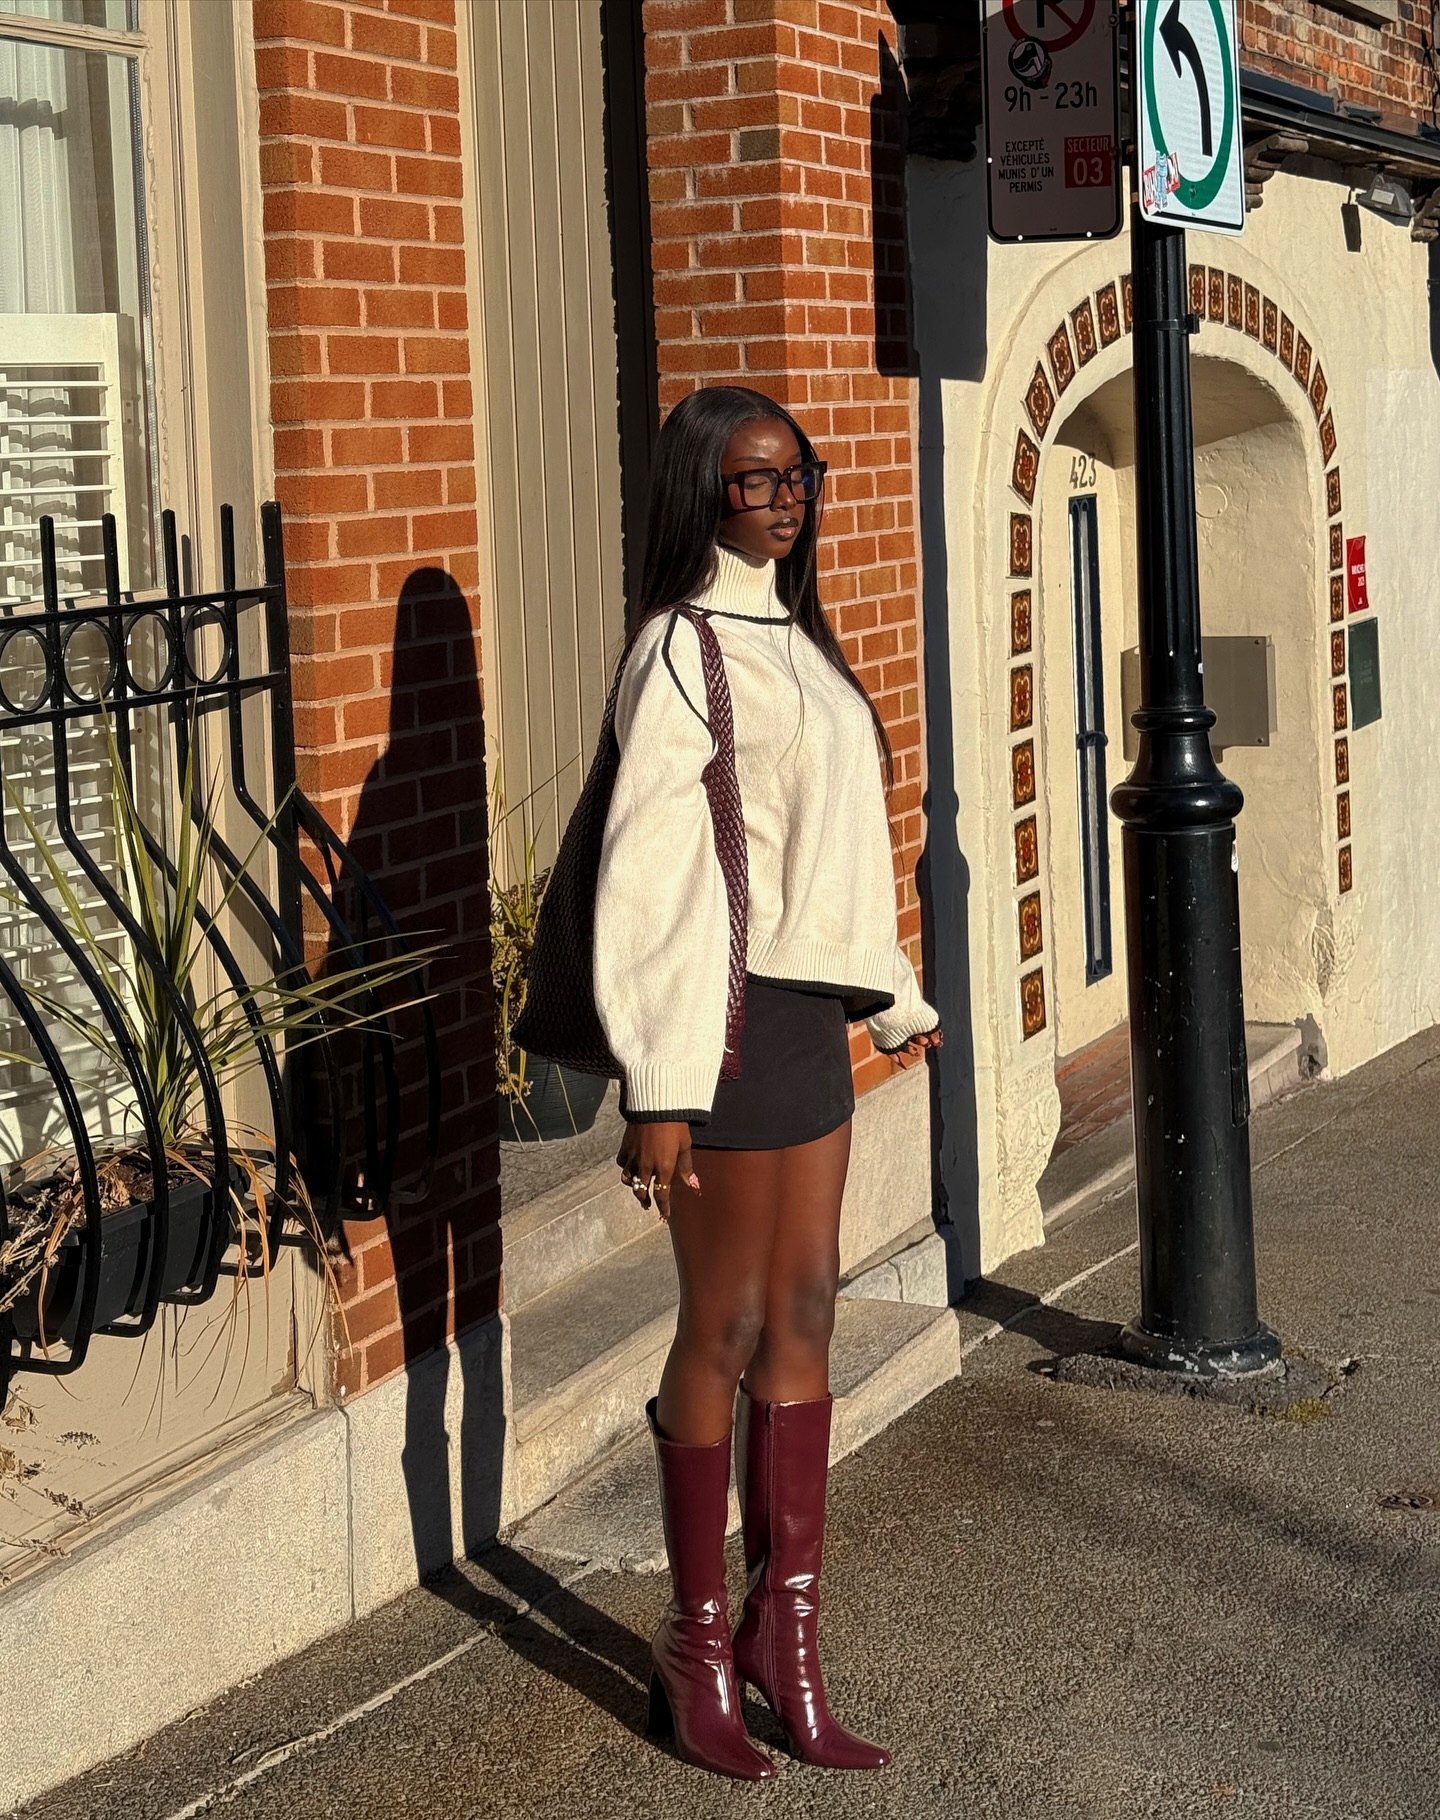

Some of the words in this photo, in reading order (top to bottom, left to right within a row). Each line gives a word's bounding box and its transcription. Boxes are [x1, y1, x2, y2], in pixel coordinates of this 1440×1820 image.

[1004, 85, 1031, 112] 9h
[1055, 81, 1097, 109] 23h
[1005, 137, 1045, 152] EXCEPTÉ
[1067, 137, 1109, 153] SECTEUR
[1000, 153, 1050, 166] VÉHICULES
[998, 168, 1026, 180] MUNIS
[1073, 157, 1104, 185] 03
[1009, 181, 1043, 193] PERMIS
[1069, 454, 1097, 489] 423
